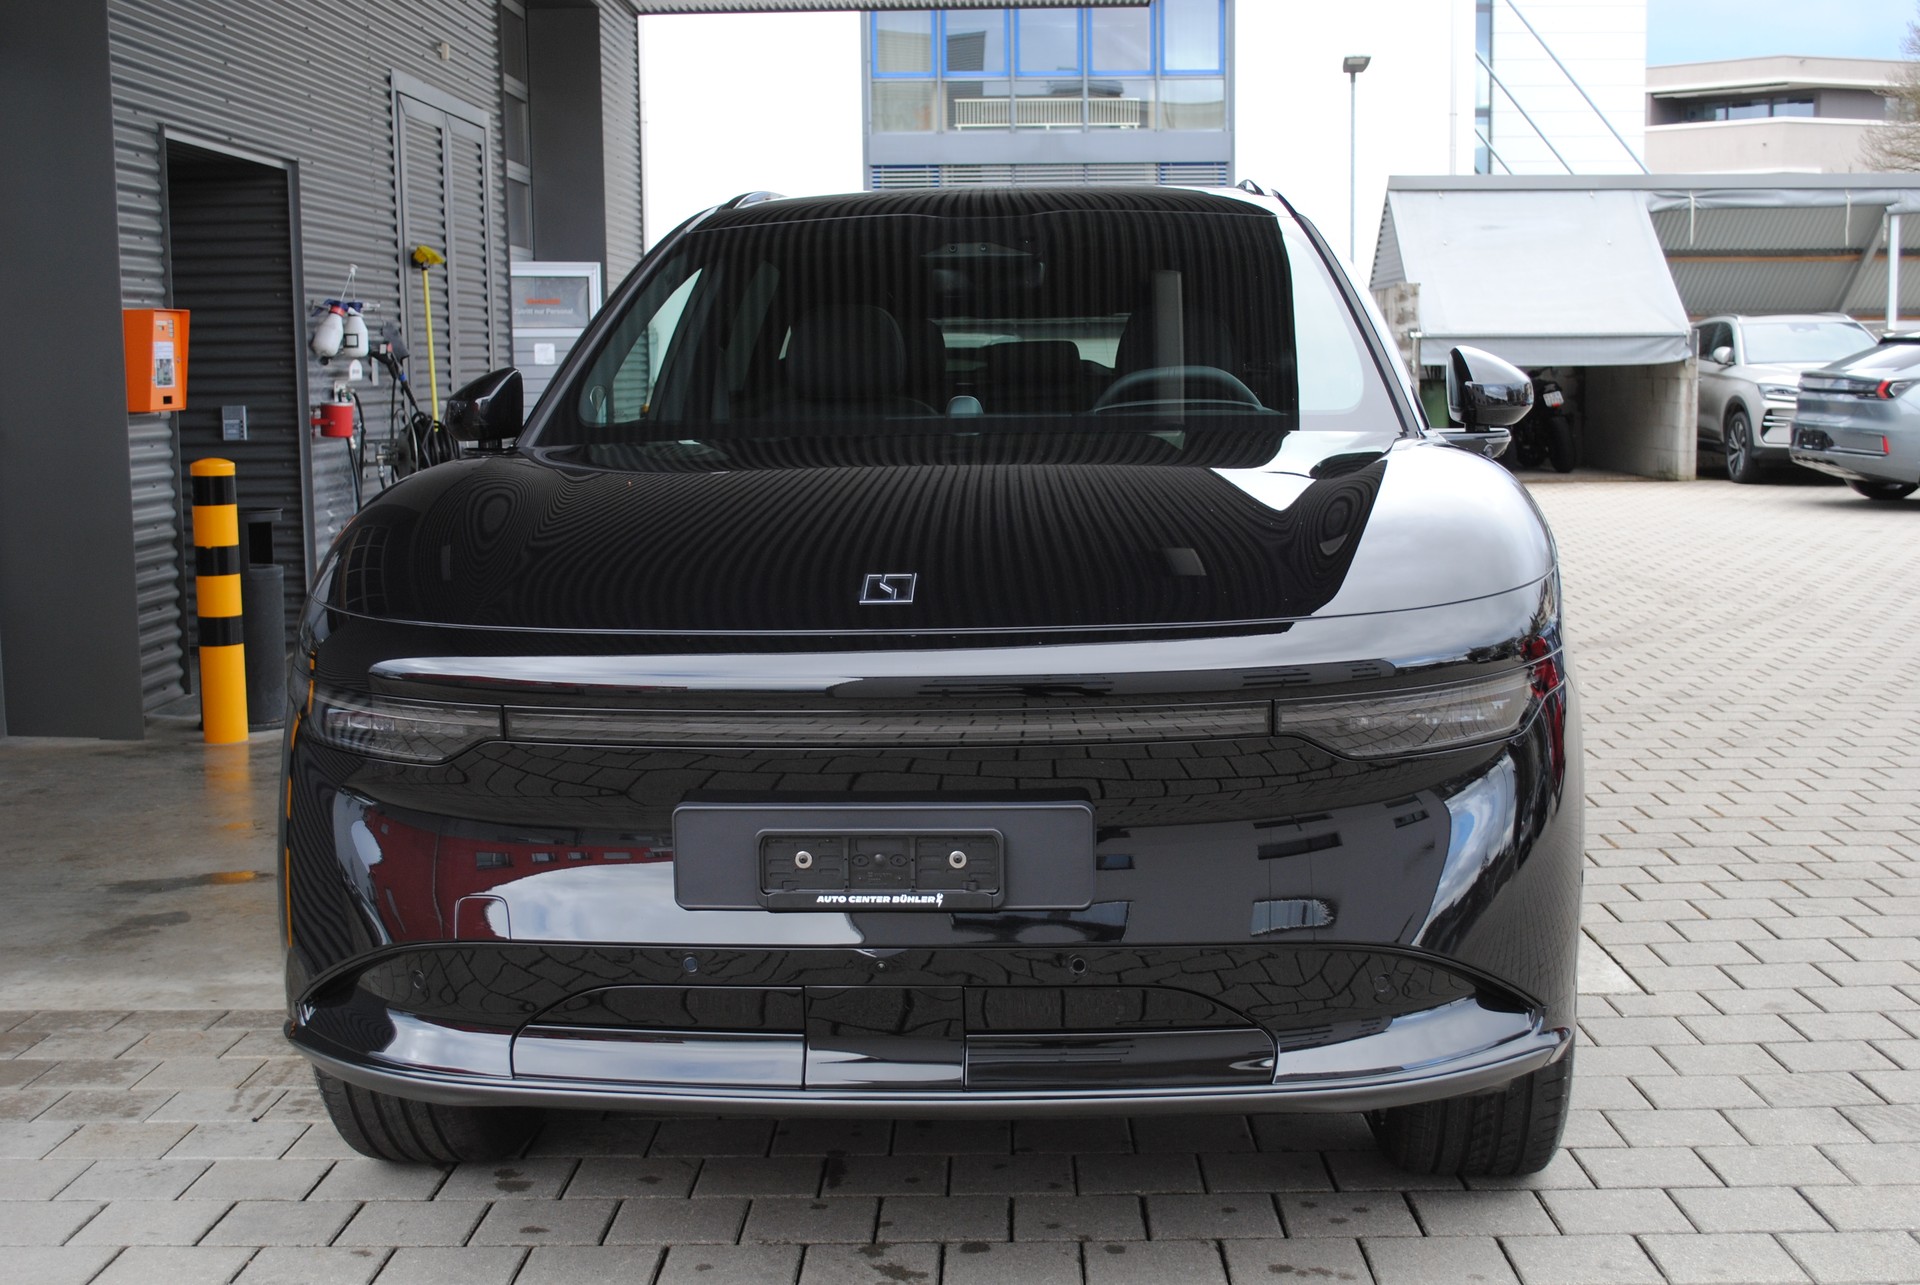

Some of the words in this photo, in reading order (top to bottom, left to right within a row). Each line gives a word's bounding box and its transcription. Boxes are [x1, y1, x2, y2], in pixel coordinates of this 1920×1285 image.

[816, 895, 847, 903] AUTO
[848, 895, 891, 903] CENTER
[892, 894, 936, 903] BÜHLER
